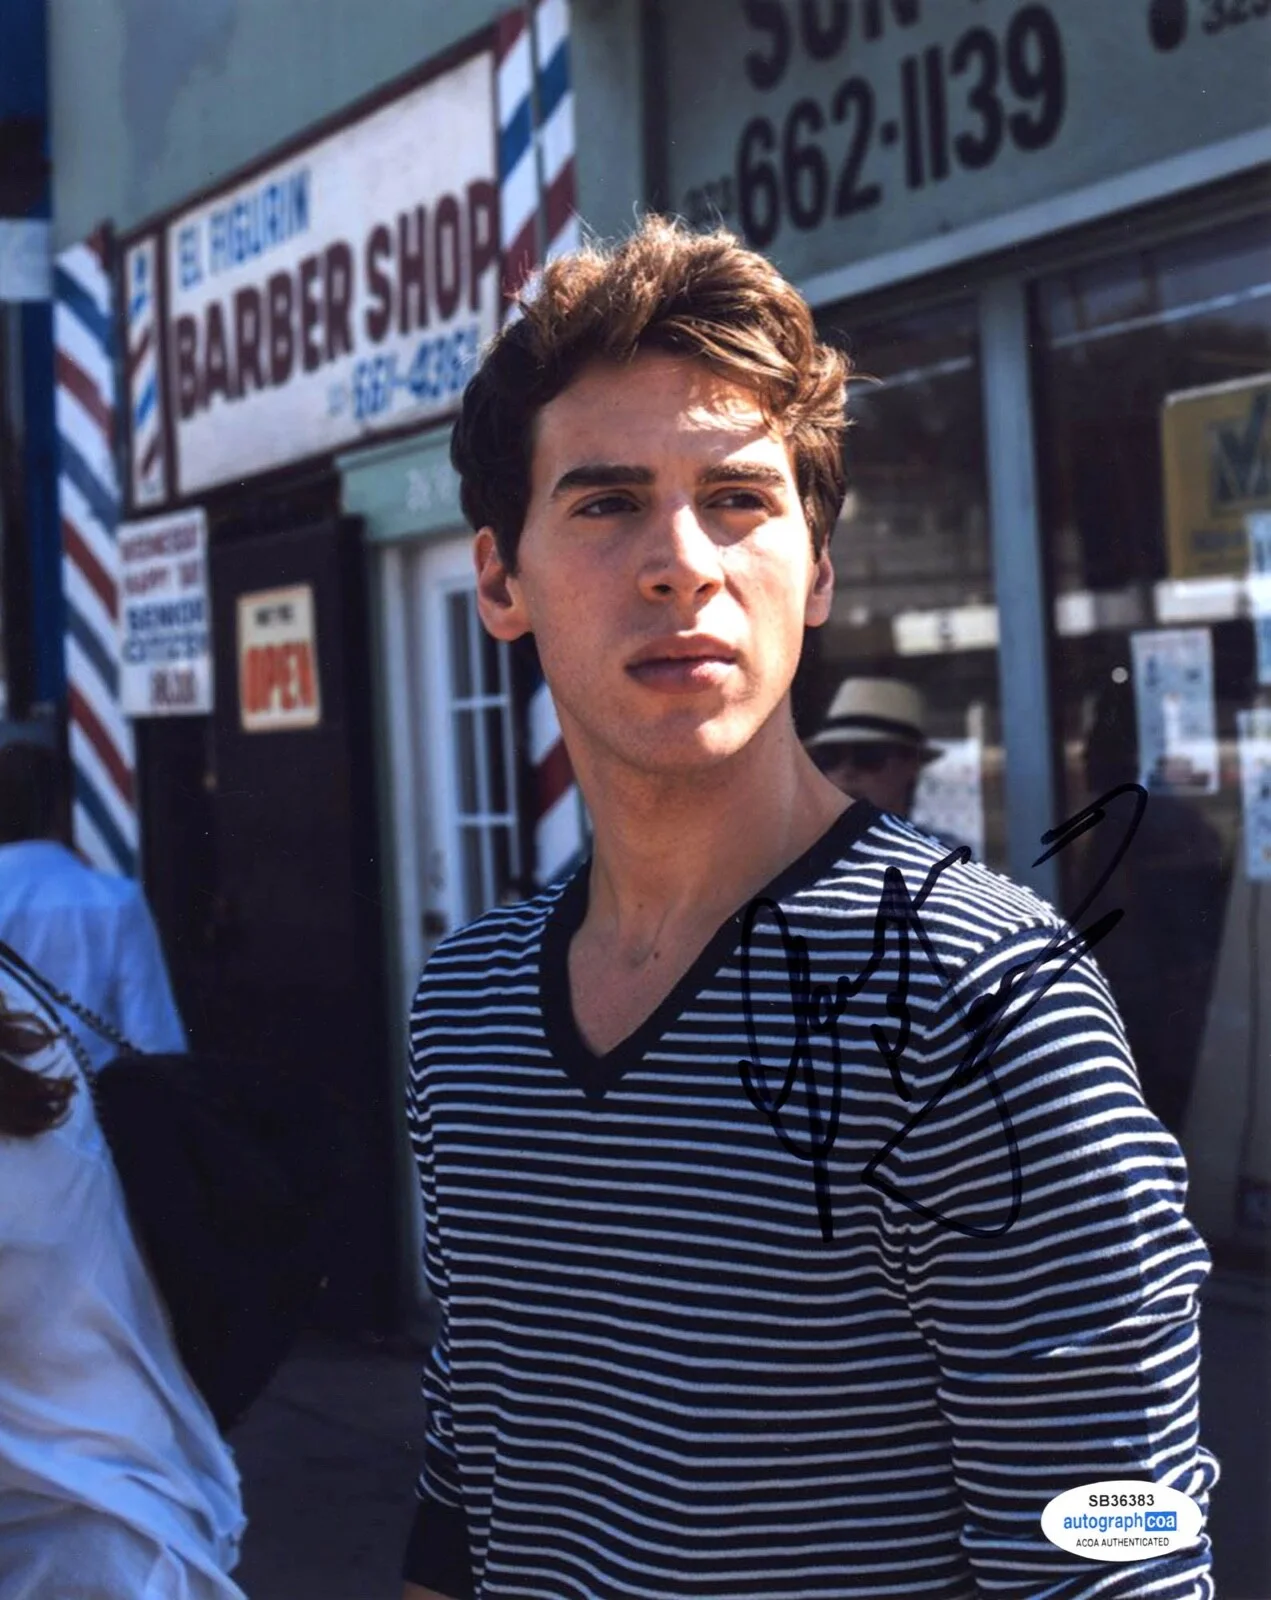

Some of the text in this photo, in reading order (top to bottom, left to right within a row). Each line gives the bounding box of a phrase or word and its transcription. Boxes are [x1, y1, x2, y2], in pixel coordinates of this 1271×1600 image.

[174, 179, 498, 421] BARBER SHOP
[1088, 1494, 1155, 1507] SB36383
[1076, 1537, 1169, 1548] ACOA AUTHENTICATED
